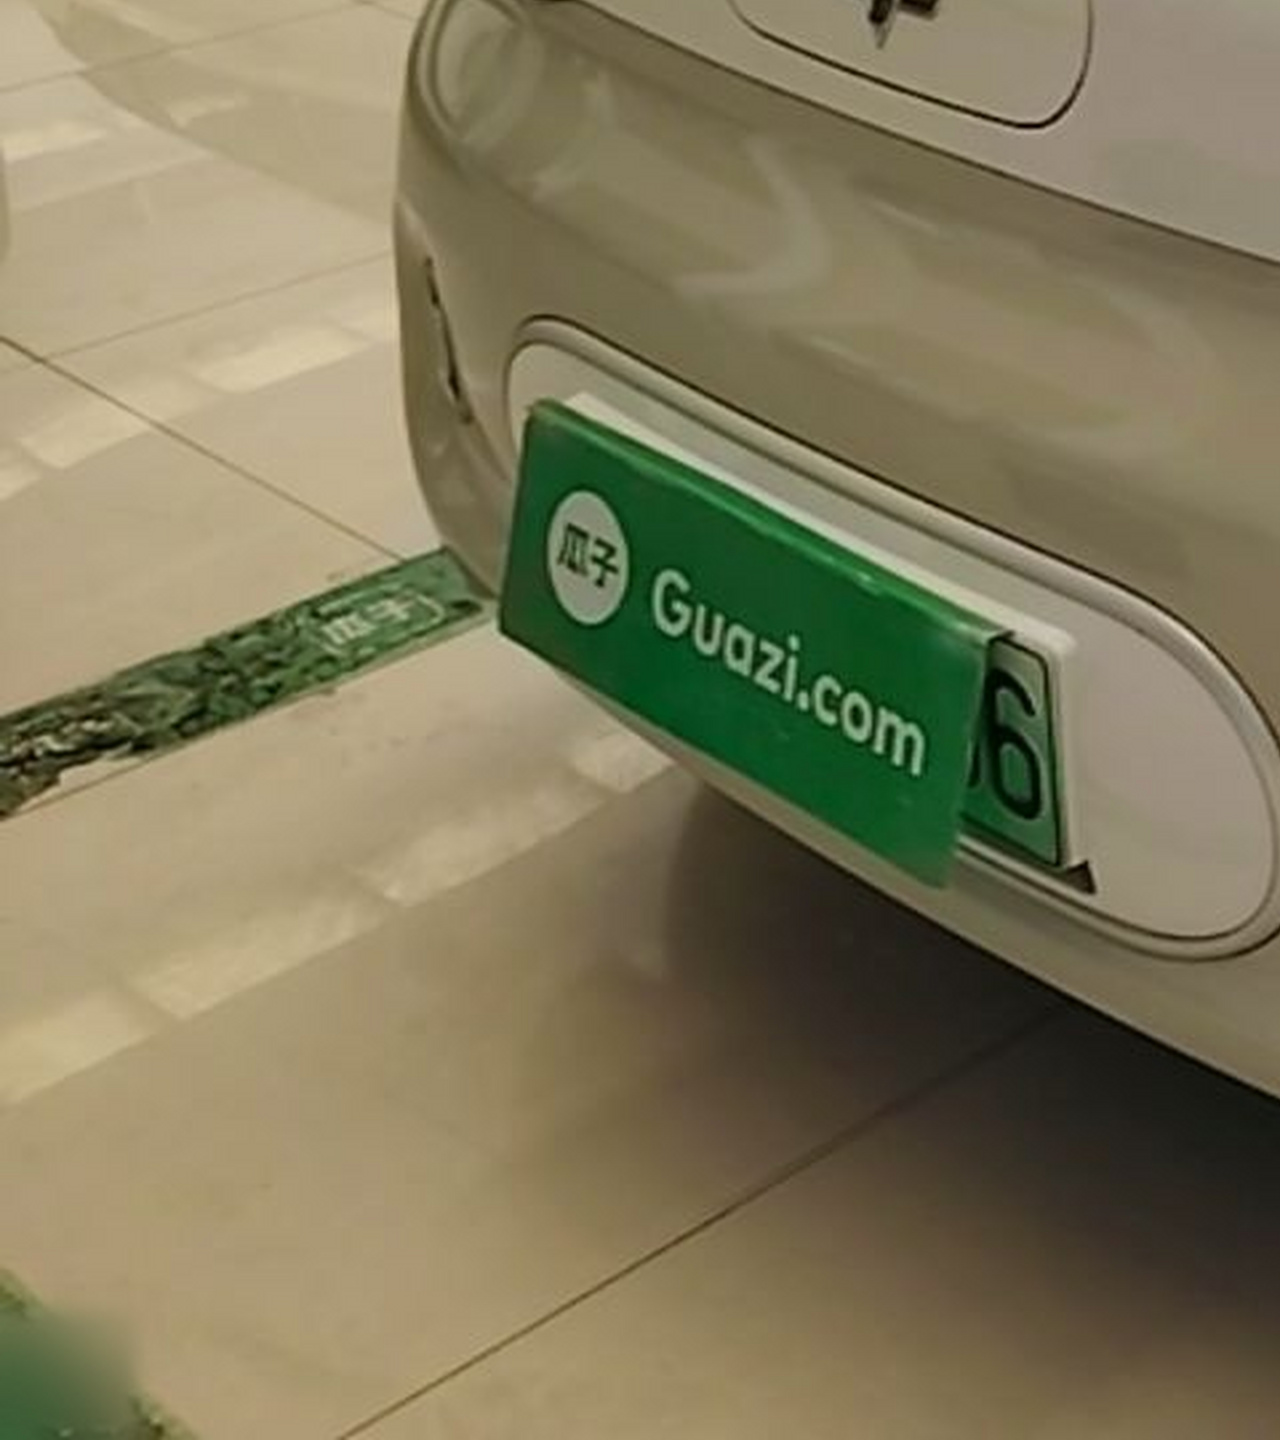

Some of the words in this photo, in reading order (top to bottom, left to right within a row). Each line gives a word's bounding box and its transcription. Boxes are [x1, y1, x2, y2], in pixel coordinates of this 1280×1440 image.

[556, 521, 621, 590] 瓜子
[650, 567, 927, 777] Guazi.com
[967, 666, 1042, 822] 6
